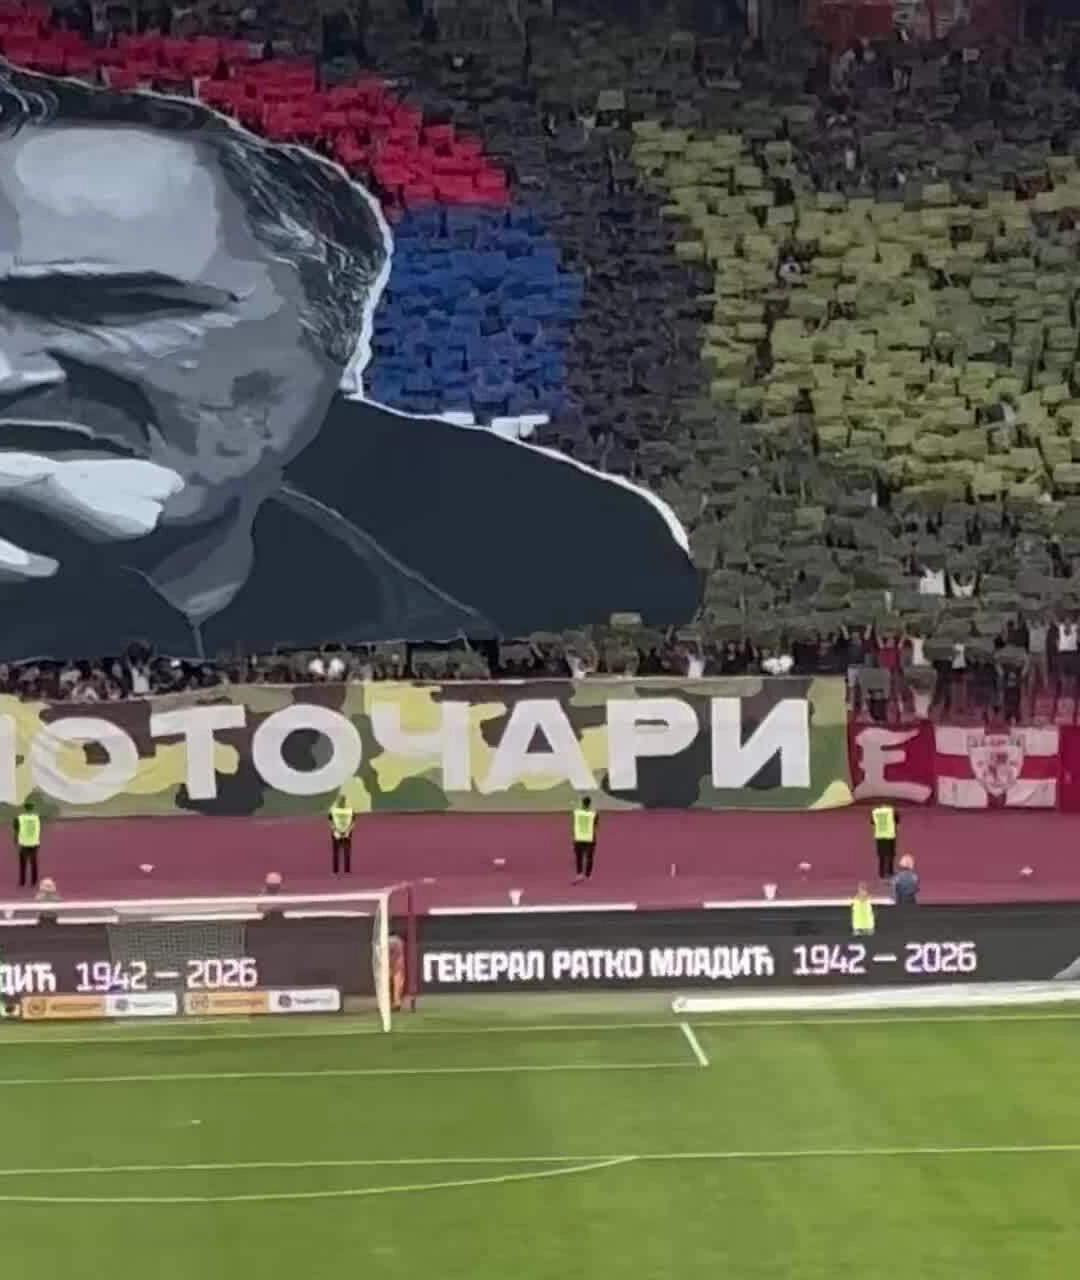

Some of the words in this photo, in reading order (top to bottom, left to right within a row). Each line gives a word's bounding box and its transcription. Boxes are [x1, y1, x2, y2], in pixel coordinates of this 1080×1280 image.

[75, 960, 148, 992] 1942
[186, 958, 258, 989] 2026
[422, 949, 545, 983] ГЕНЕРАЛ
[551, 947, 643, 980] РАТКО
[649, 944, 775, 981] МЛАДИЋ
[792, 944, 867, 975] 1942
[904, 941, 977, 973] 2026
